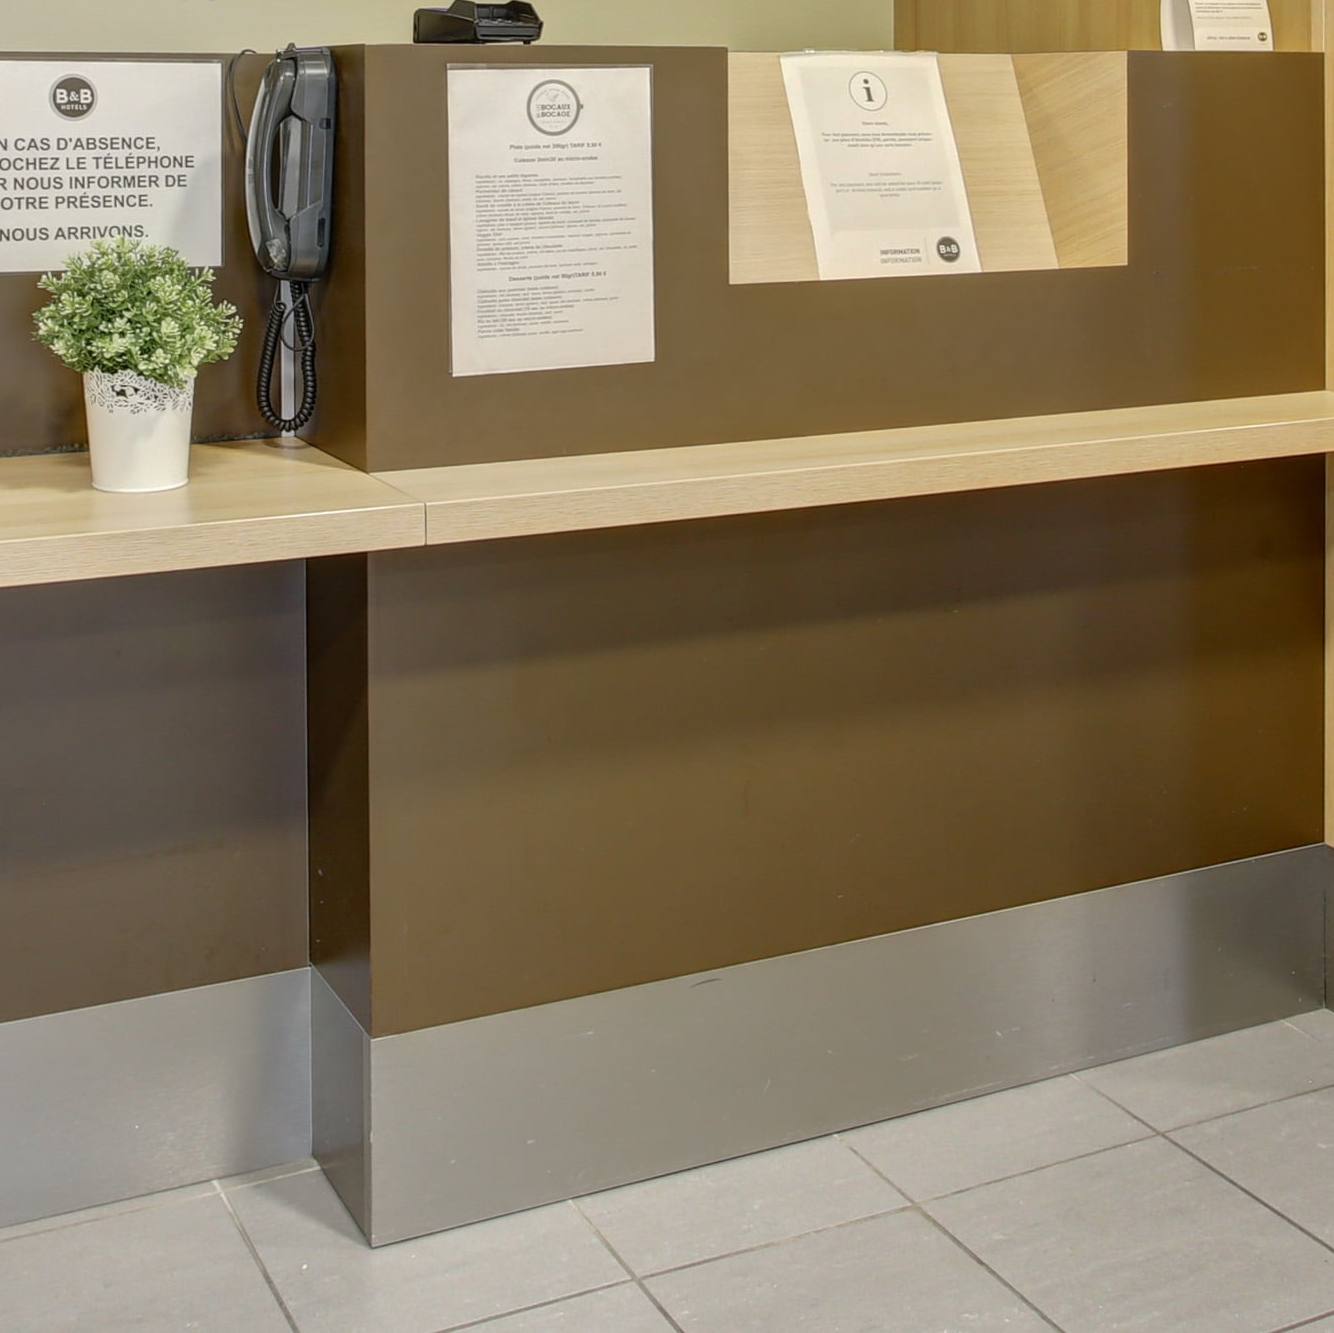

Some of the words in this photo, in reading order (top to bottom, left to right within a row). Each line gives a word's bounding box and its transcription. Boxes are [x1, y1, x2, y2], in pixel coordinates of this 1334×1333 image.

[55, 88, 92, 103] B&B
[14, 137, 51, 151] CAS
[56, 136, 161, 152] D'ABSENCE,
[66, 157, 87, 170] LE
[92, 153, 195, 170] TÉLÉPHONE
[13, 177, 63, 190] NOUS
[69, 175, 159, 189] INFORMER
[165, 174, 187, 187] DE
[55, 192, 153, 209] PRÉSENCE.
[939, 244, 958, 253] B&B
